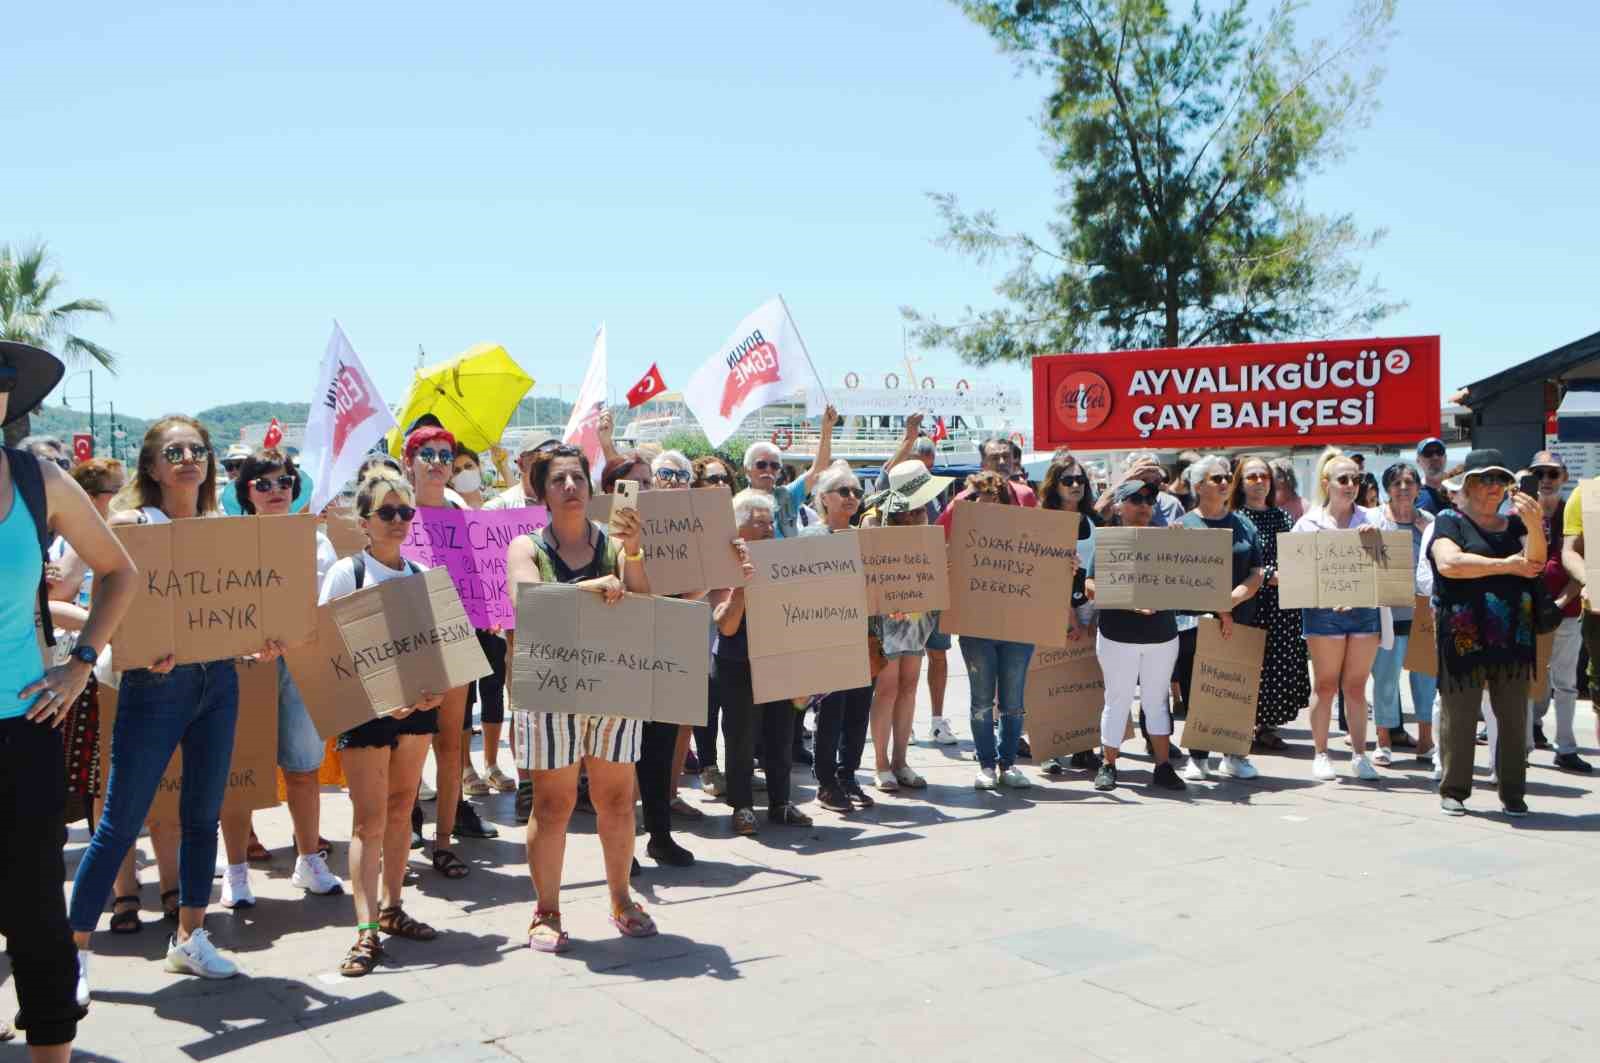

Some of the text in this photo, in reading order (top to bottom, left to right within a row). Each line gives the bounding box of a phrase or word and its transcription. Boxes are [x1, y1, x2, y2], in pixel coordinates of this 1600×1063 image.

[1128, 350, 1381, 396] AYVALIKGÜCÜ
[1133, 391, 1375, 437] ÇAY BAHÇESİ
[644, 543, 689, 561] HAYIR
[965, 528, 1014, 553] SOKAK
[771, 558, 858, 580] SOKAKTAYIM
[147, 567, 284, 598] KATLİAMA
[188, 603, 257, 630] HAYIR
[781, 603, 859, 626] YANINDAYIM
